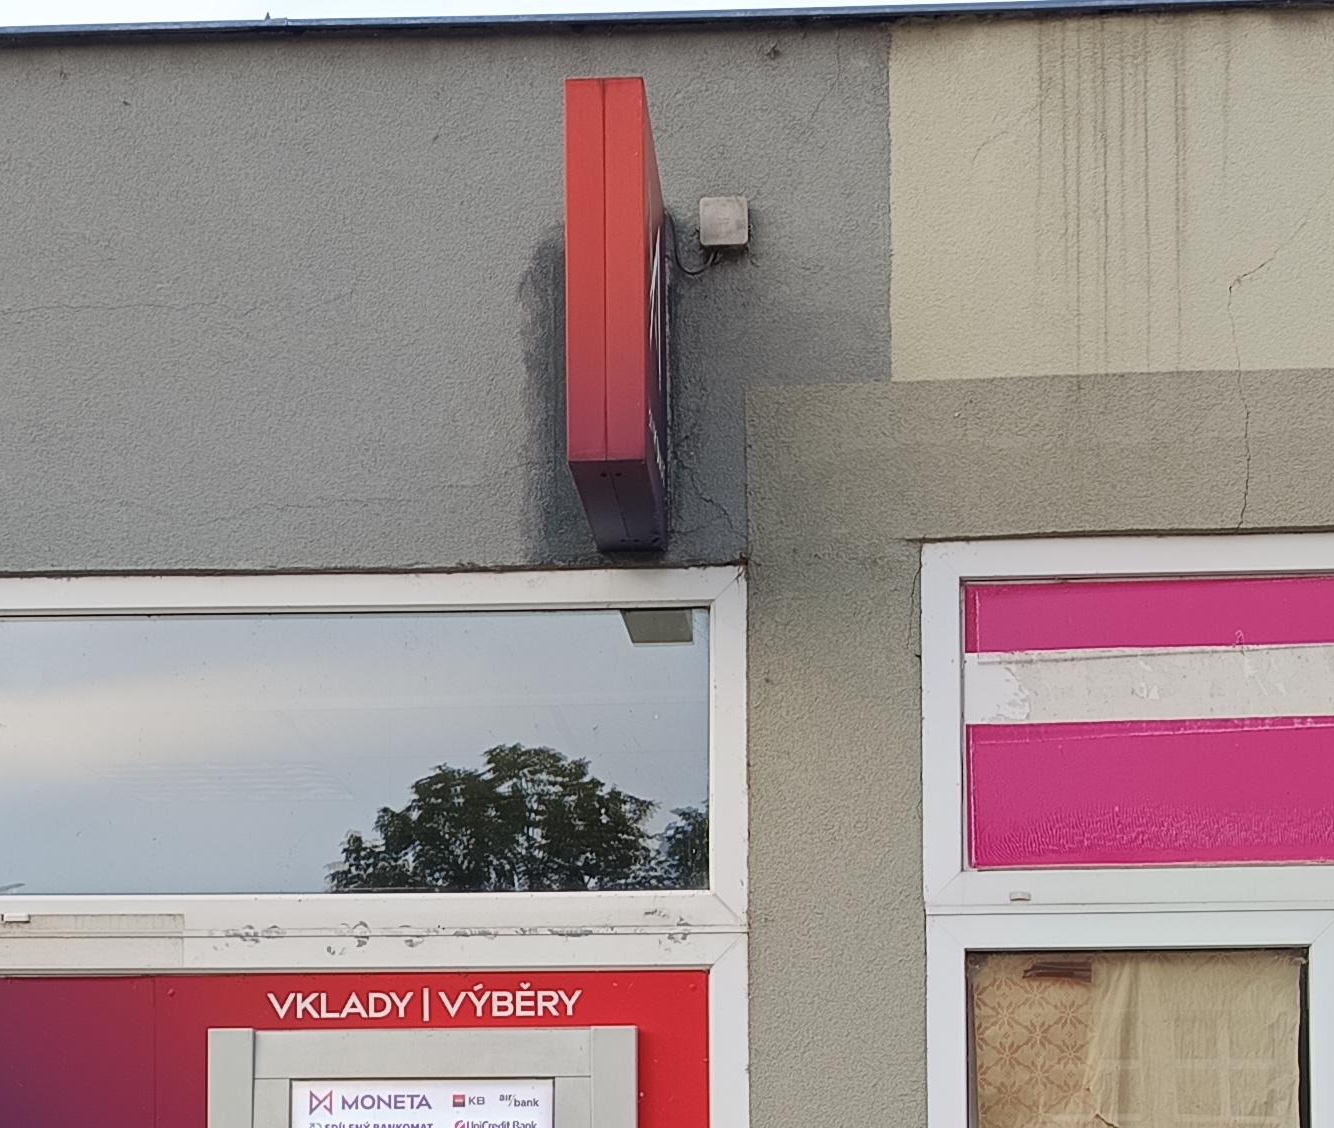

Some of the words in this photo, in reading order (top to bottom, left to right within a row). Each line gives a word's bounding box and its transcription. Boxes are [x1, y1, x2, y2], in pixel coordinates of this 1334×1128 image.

[267, 991, 414, 1019] VKLADY
[438, 982, 582, 1018] VÝBĚRY
[341, 1094, 433, 1111] MONETA
[468, 1096, 486, 1106] KB
[514, 1097, 539, 1108] bank
